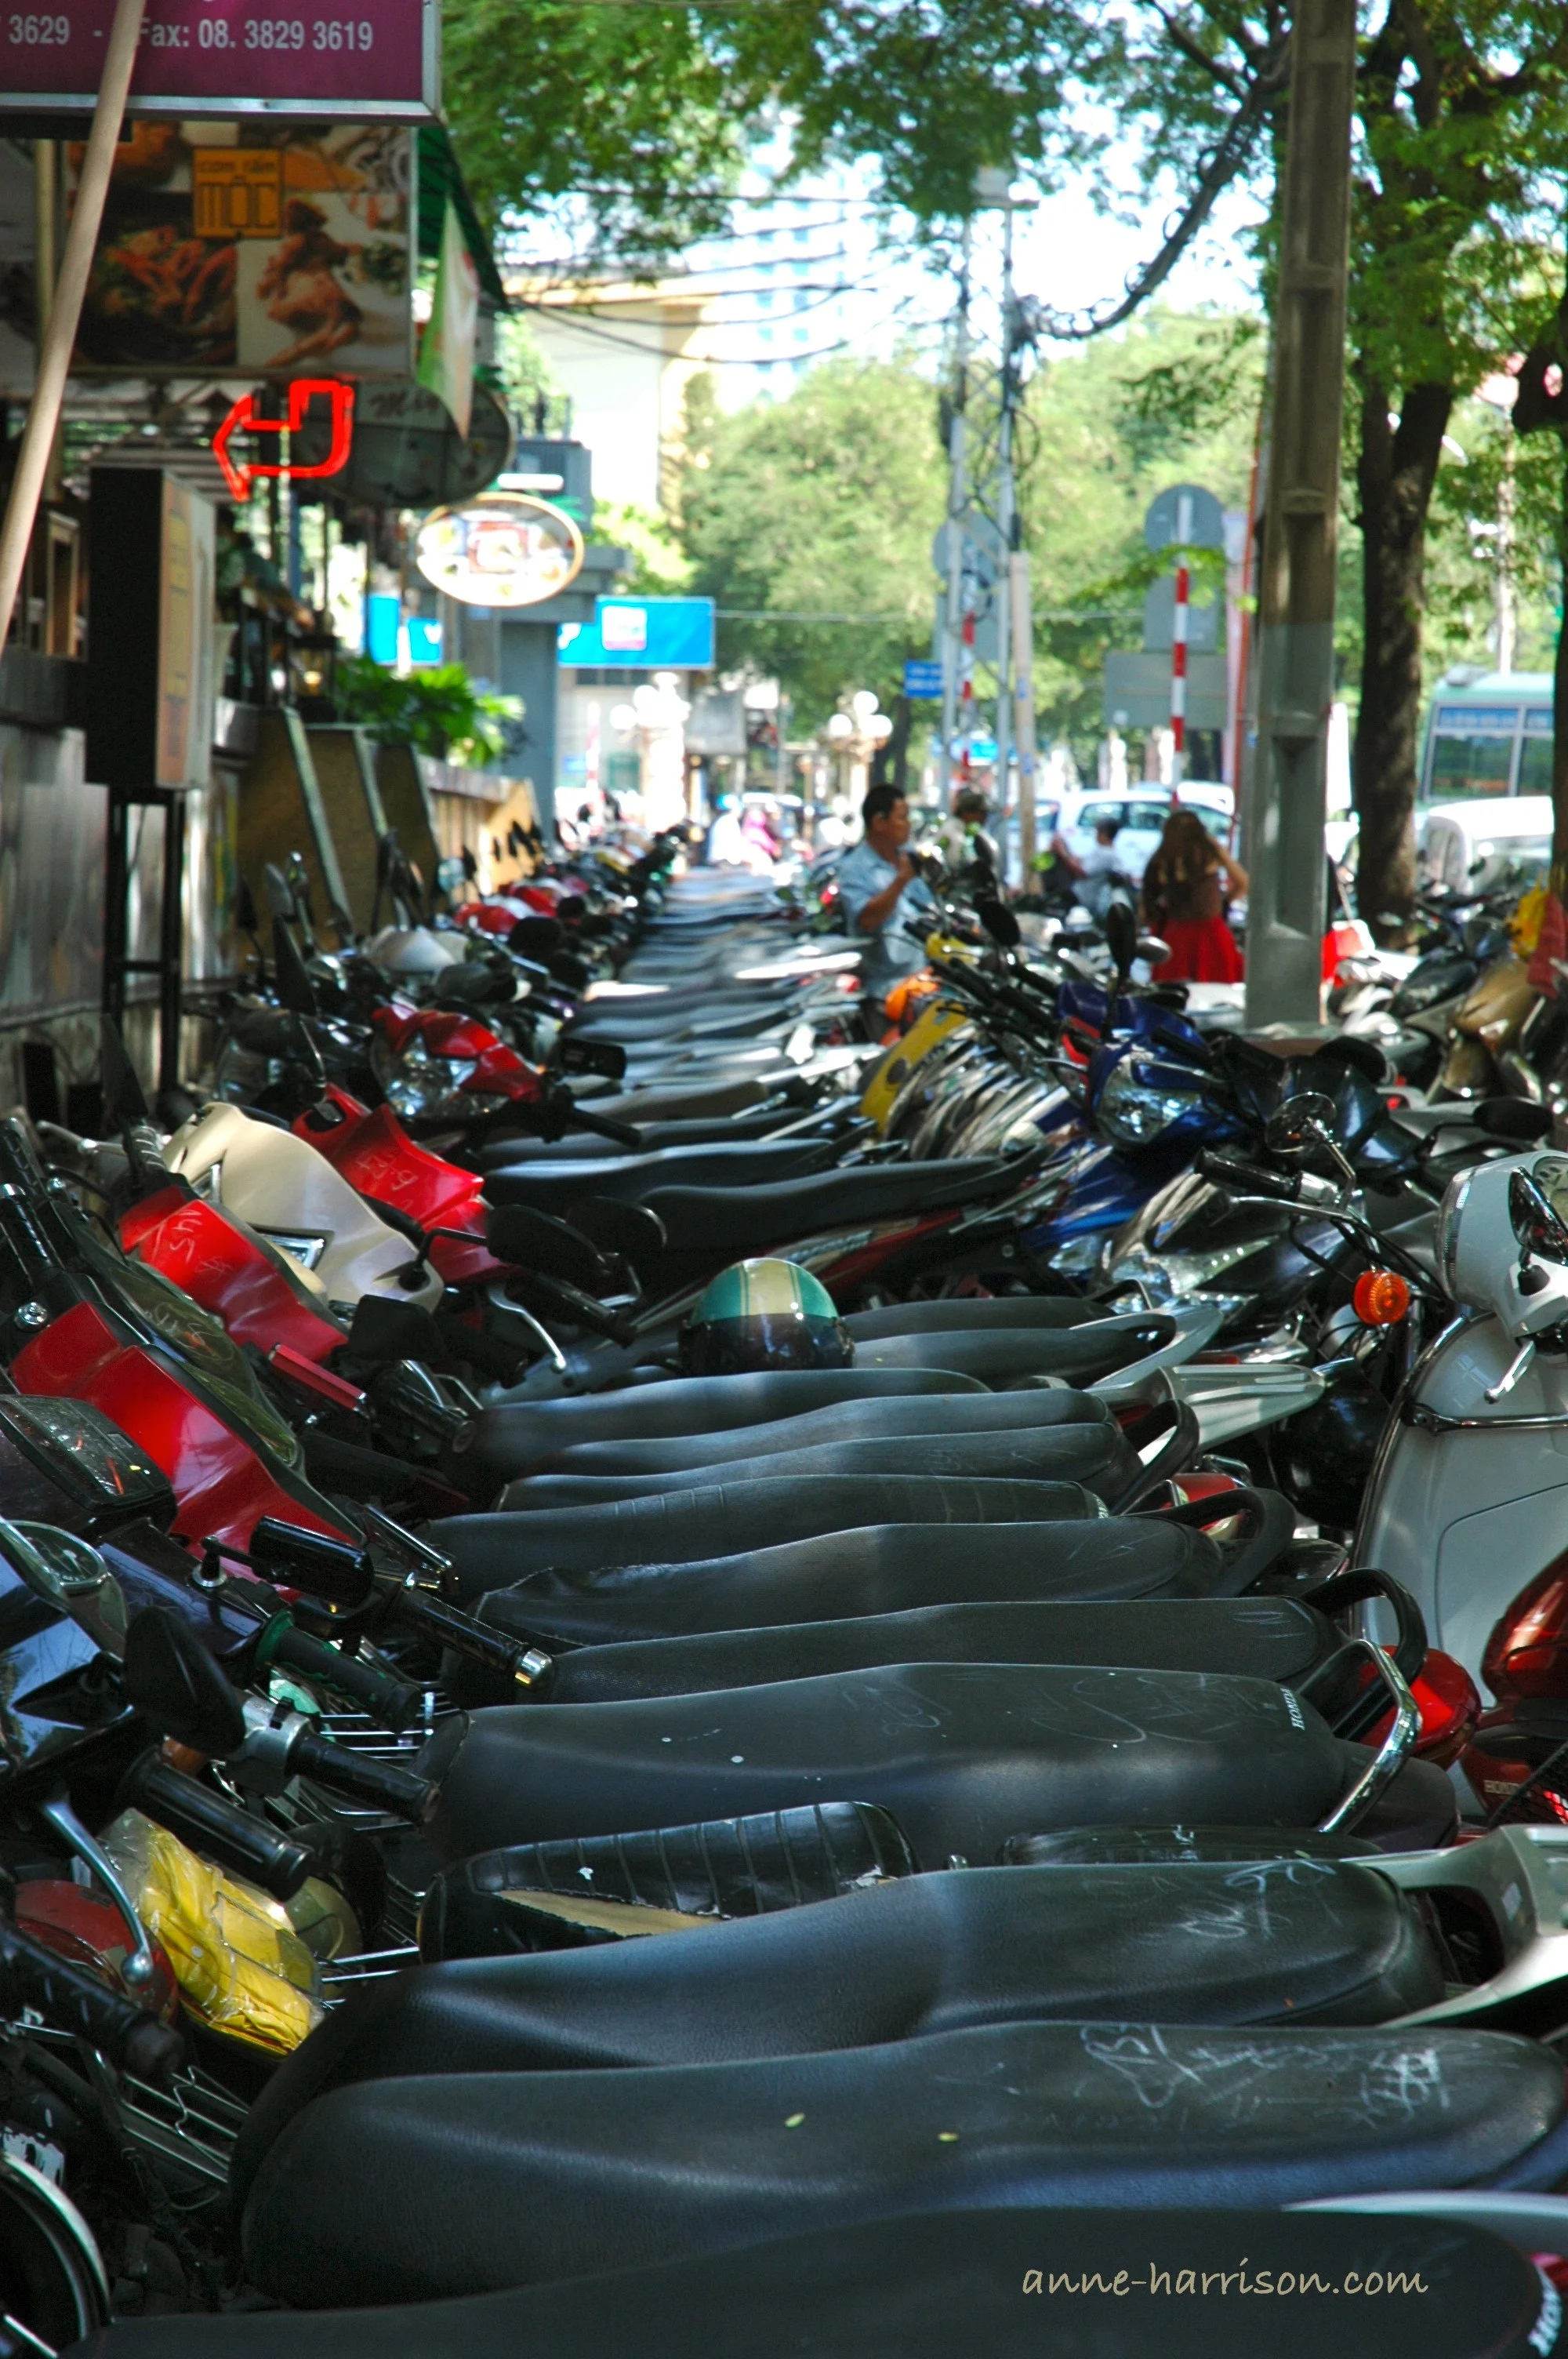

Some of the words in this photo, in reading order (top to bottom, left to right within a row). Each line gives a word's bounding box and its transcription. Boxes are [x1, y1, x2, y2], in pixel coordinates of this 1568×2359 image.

[9, 14, 70, 45] 3629
[198, 19, 236, 49] 08.
[244, 20, 305, 49] 3829
[313, 20, 374, 51] 3619
[1279, 1688, 1305, 1731] HONDA
